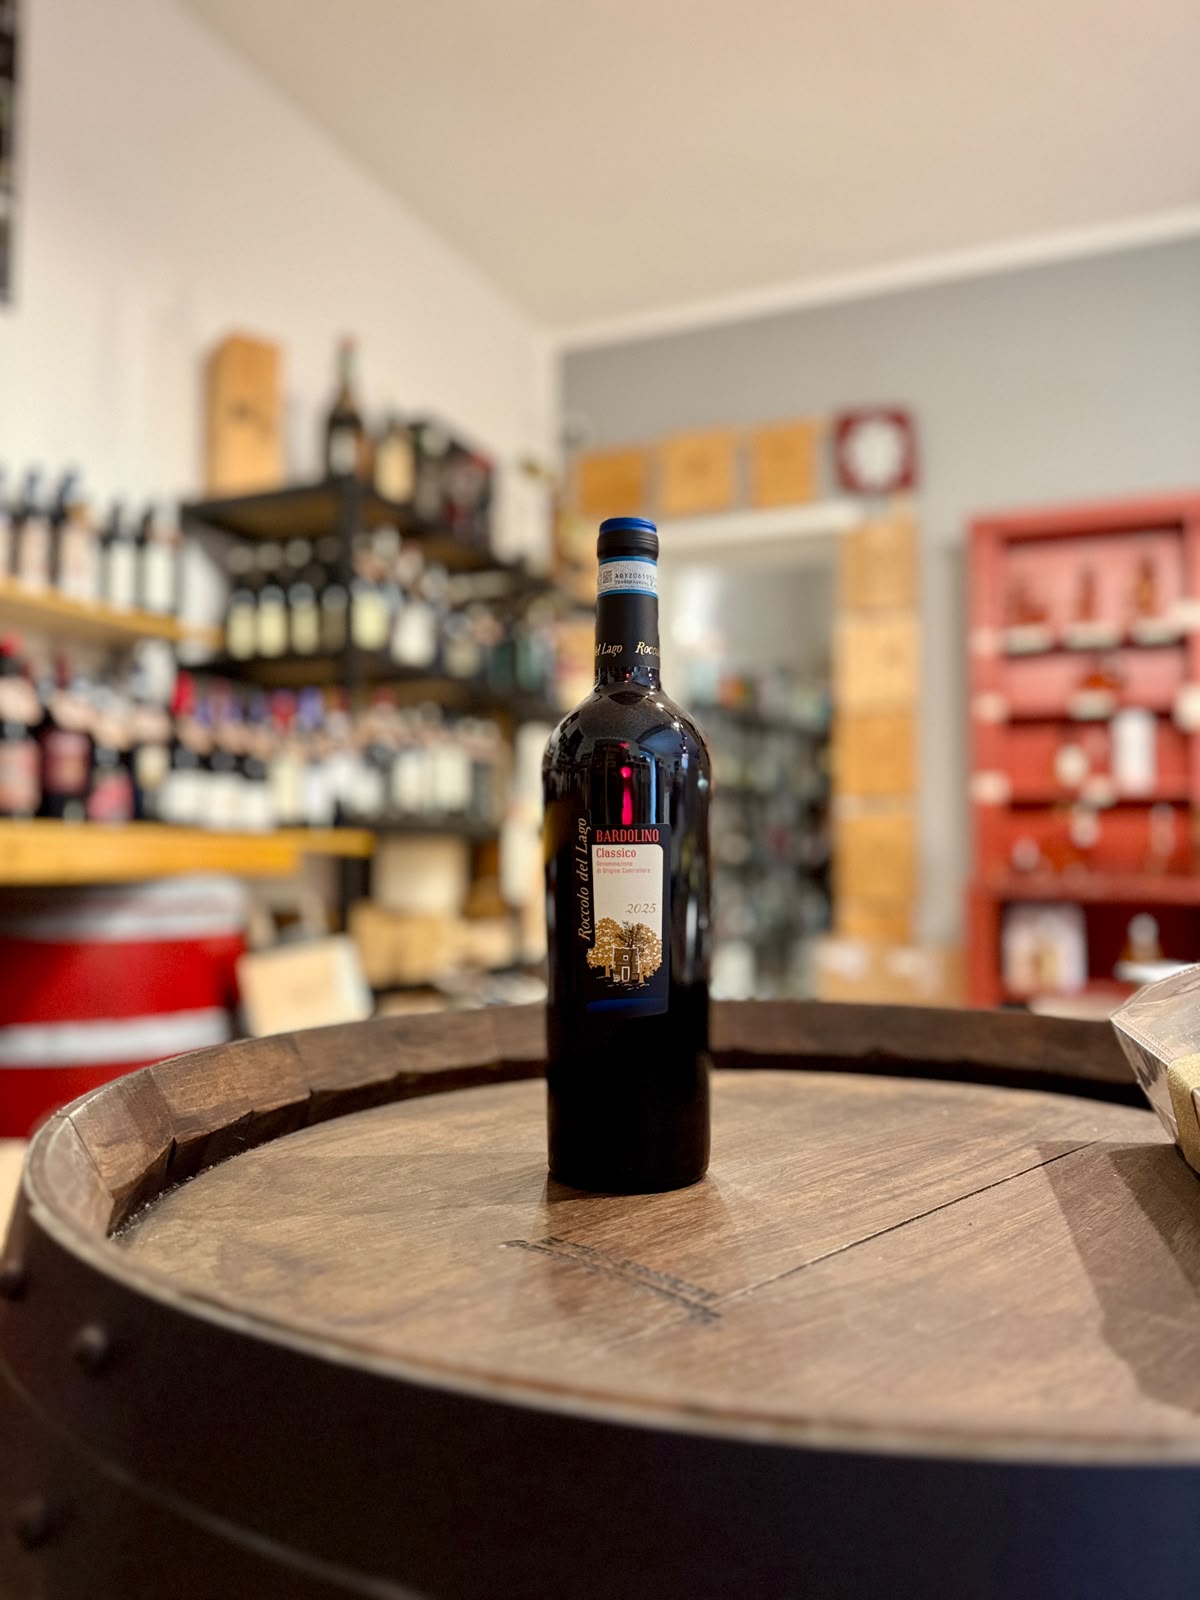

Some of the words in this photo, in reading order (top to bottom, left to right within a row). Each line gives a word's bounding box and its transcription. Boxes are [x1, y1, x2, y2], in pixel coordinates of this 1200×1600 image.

[601, 643, 622, 657] Lago
[576, 818, 592, 854] Lago
[596, 829, 659, 842] BARDOLINO
[596, 847, 637, 858] Classico
[576, 858, 589, 881] del
[577, 887, 592, 940] Roccolo
[626, 903, 656, 913] 2025
